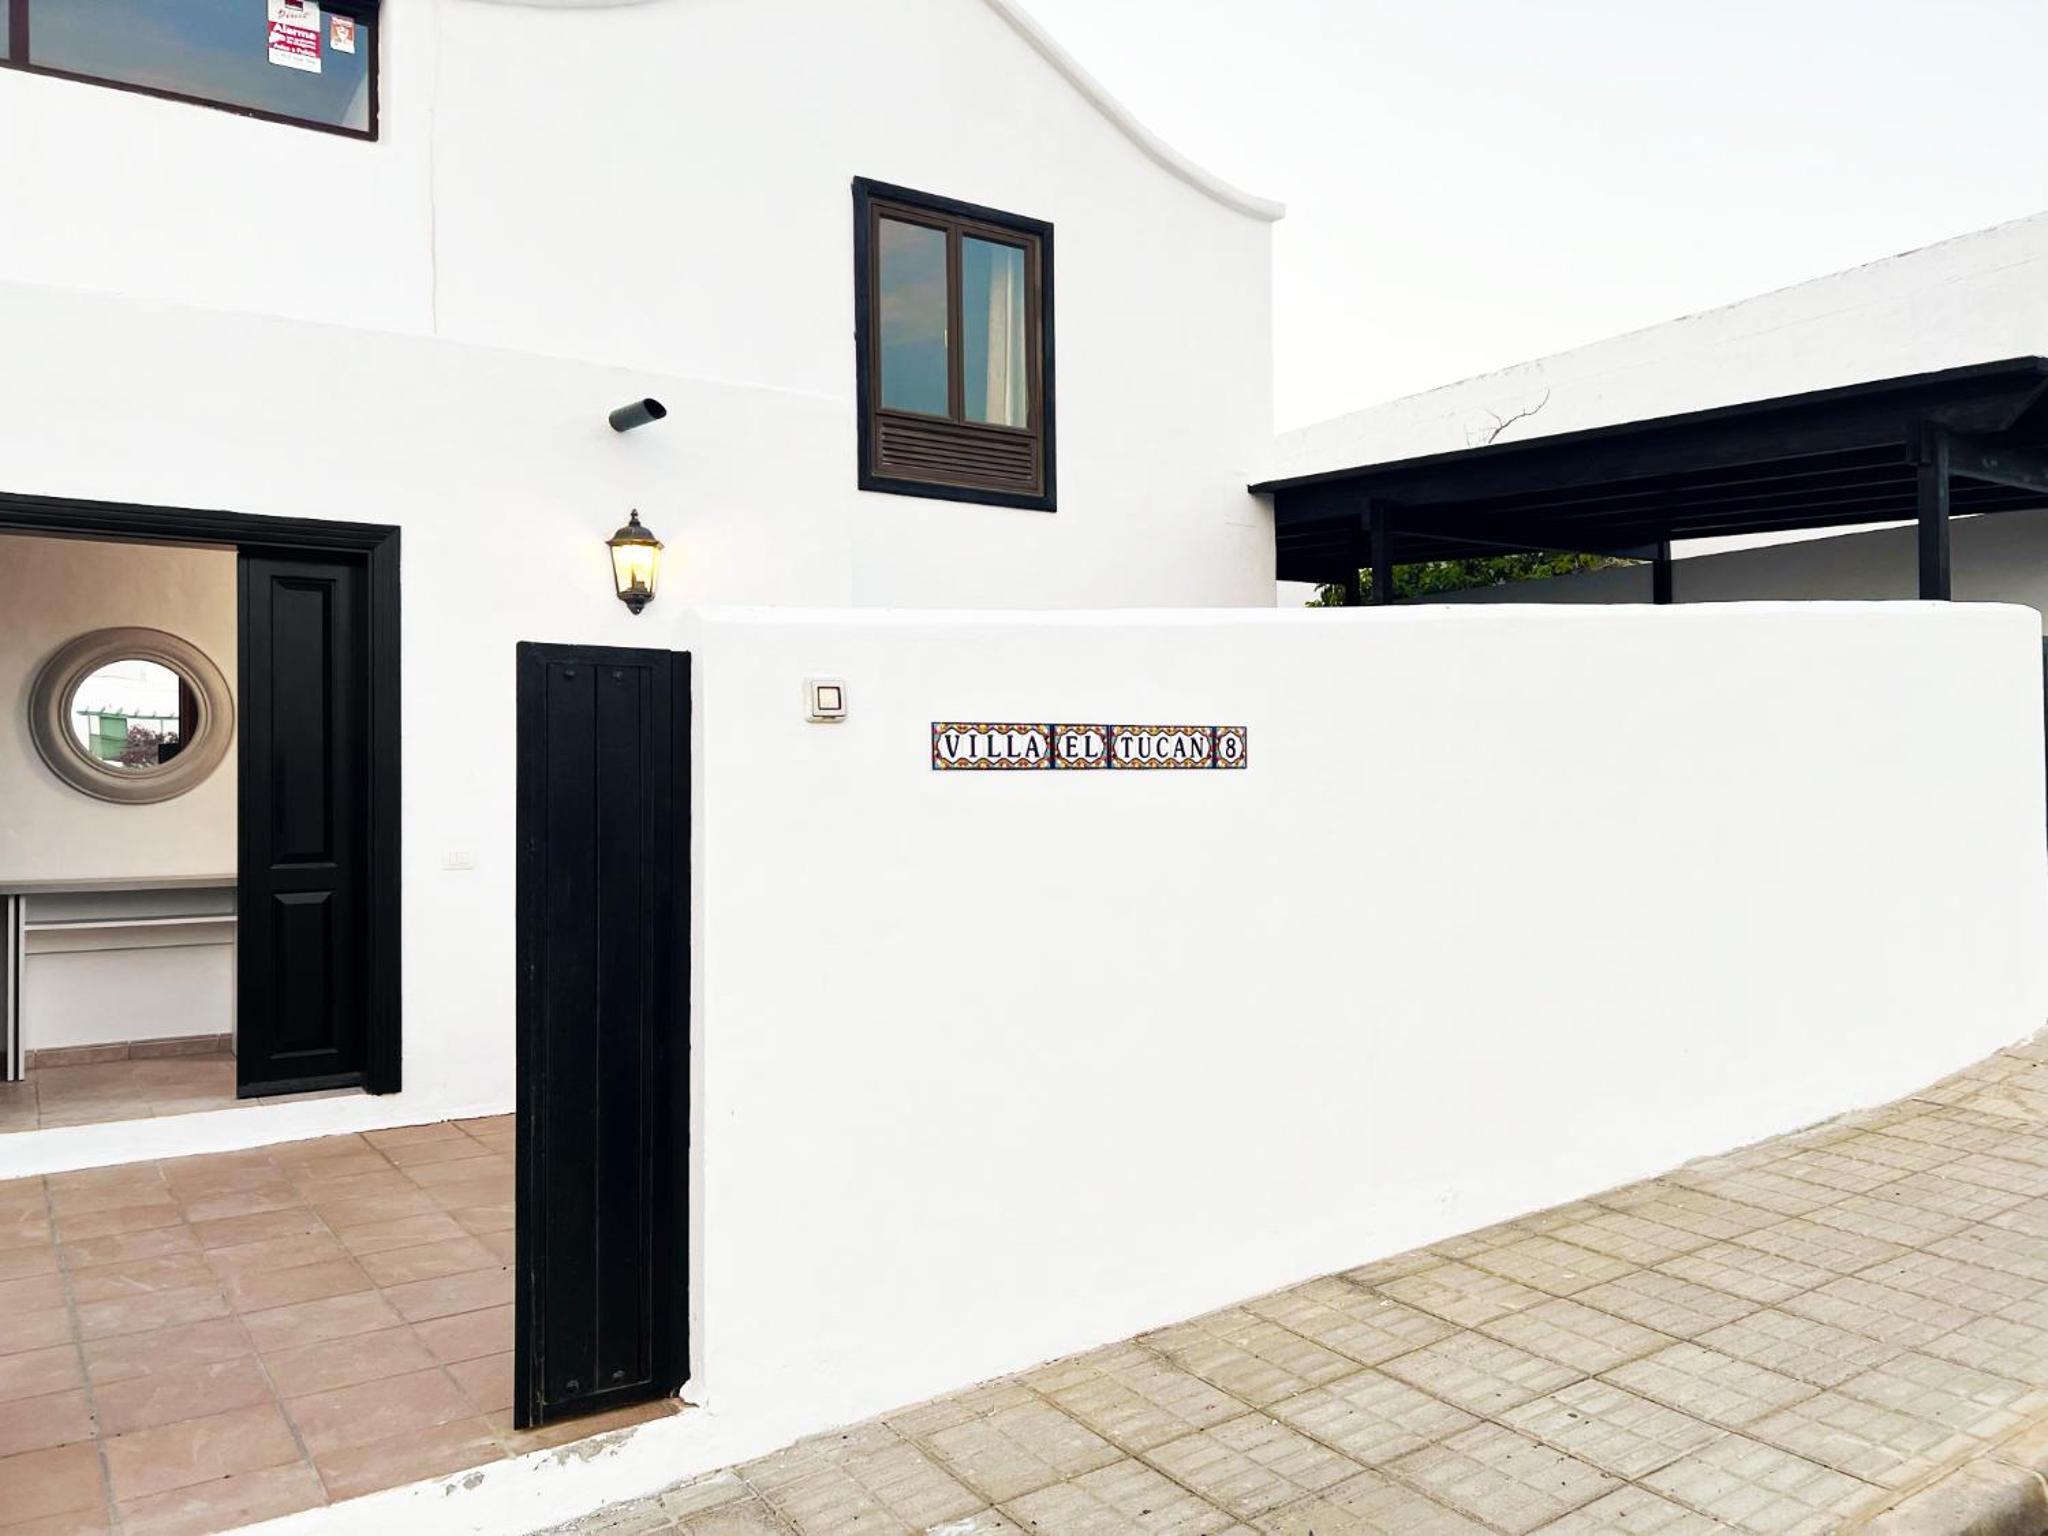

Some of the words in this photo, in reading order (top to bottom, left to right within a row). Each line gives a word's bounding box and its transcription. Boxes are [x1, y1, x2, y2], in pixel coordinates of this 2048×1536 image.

[272, 22, 317, 41] Alarma
[944, 734, 1041, 758] VILLA
[1065, 735, 1098, 758] EL
[1121, 736, 1205, 758] TUCAN
[1225, 737, 1236, 758] 8
